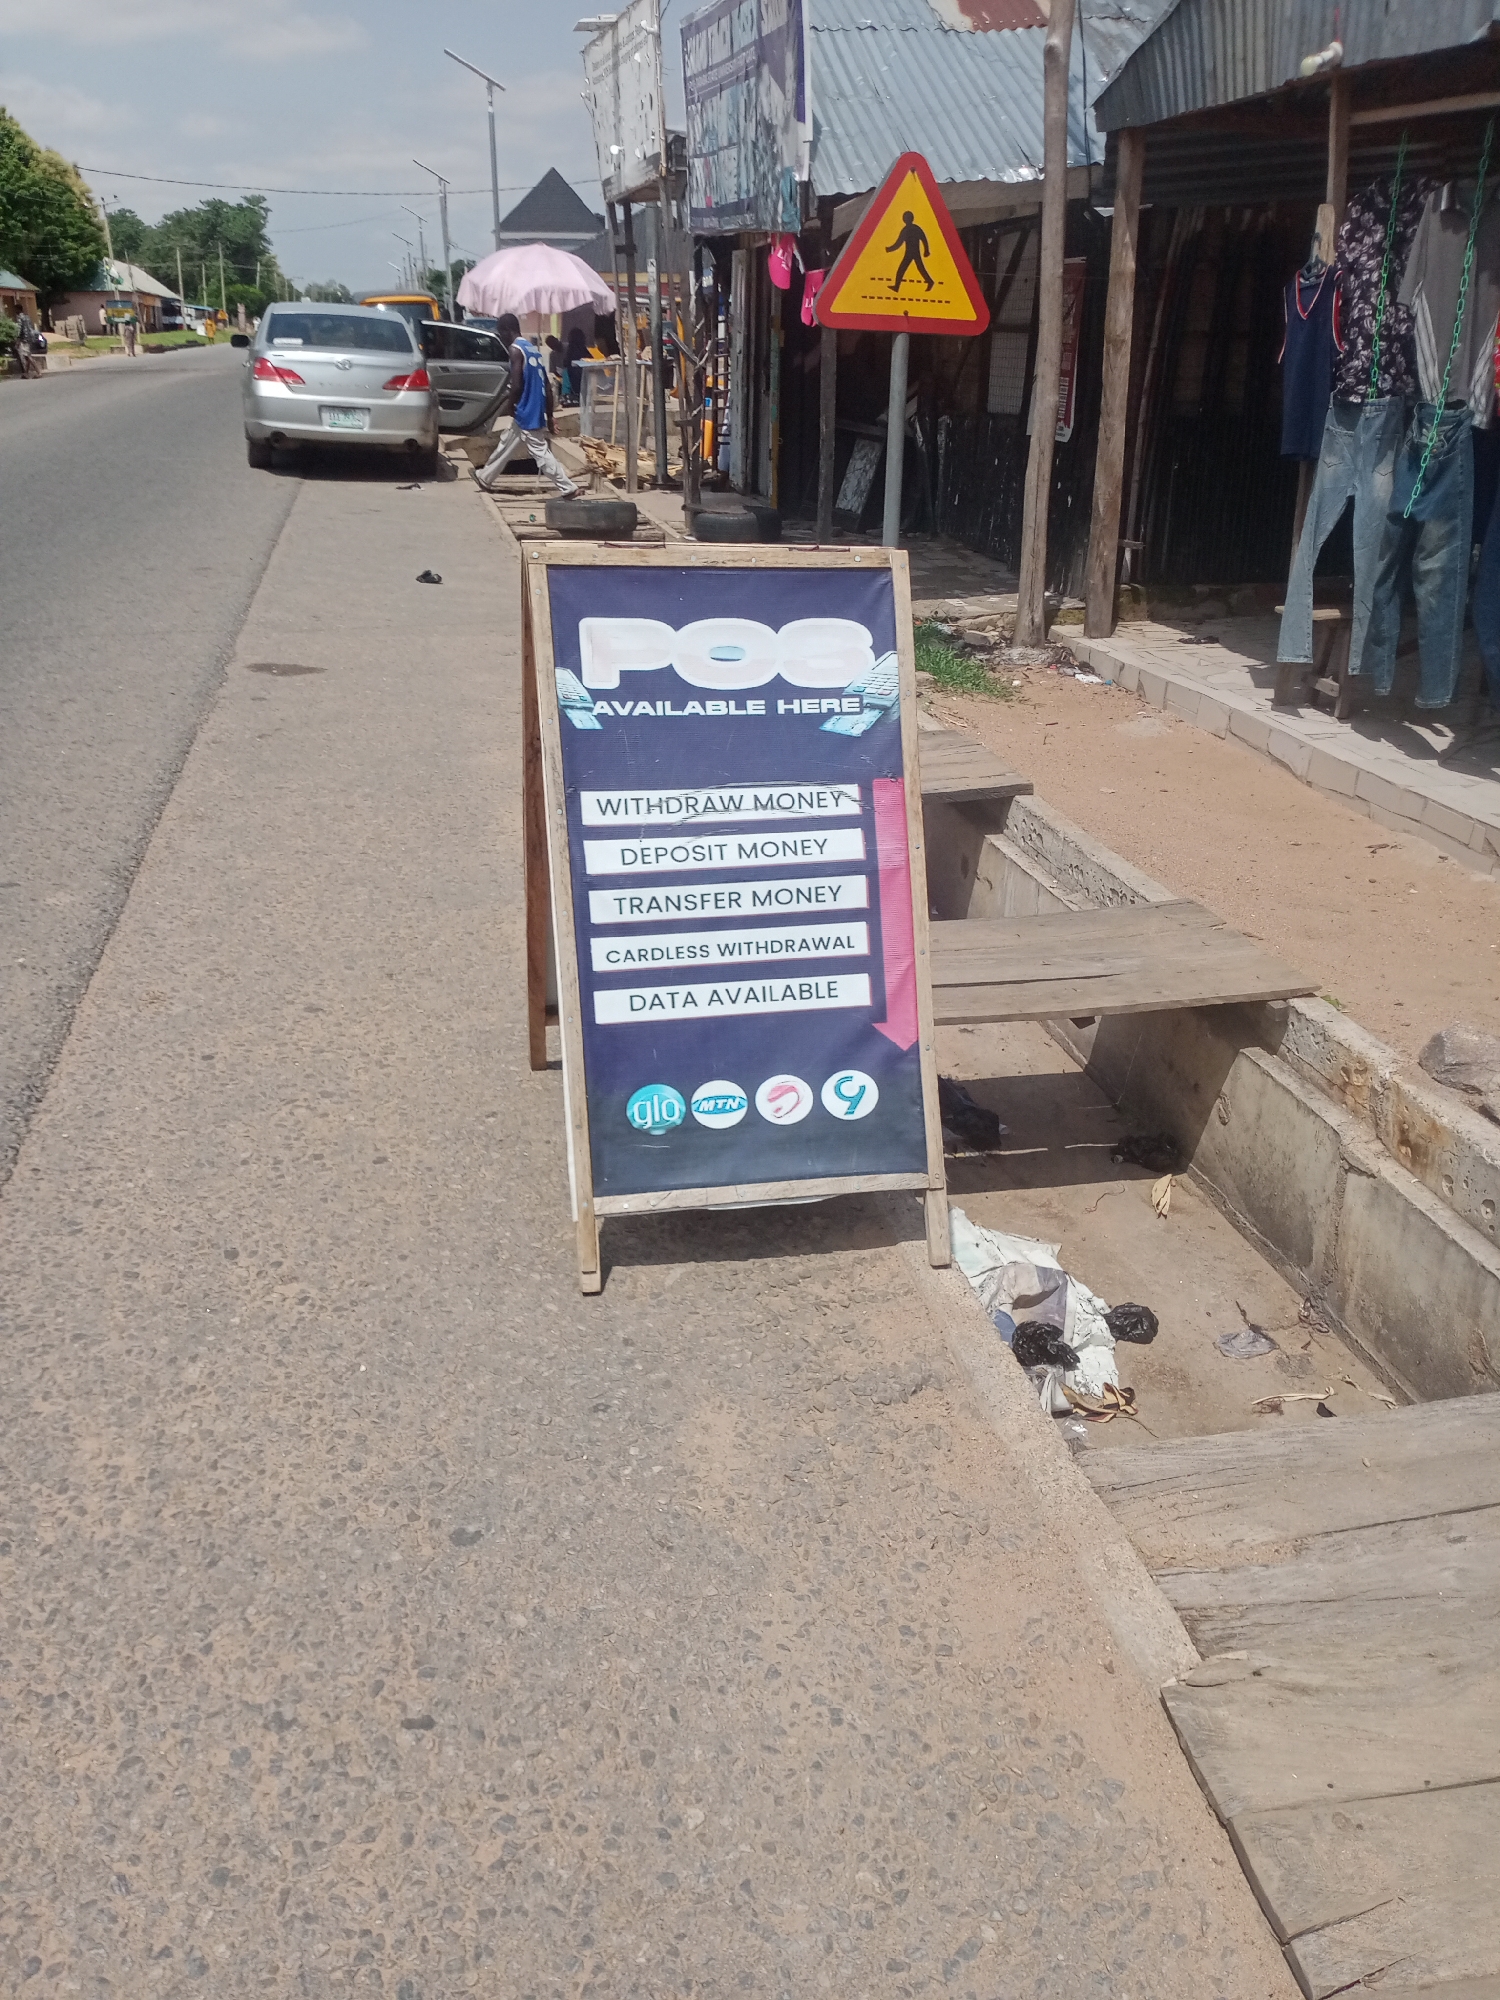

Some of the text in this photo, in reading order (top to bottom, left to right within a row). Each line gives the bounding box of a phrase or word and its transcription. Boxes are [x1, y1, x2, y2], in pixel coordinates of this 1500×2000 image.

[579, 617, 876, 690] POS
[592, 698, 861, 716] AVAILABLE HERE
[597, 791, 843, 816] WITHDRAW MONEY
[621, 838, 828, 866] DEPOSIT MONEY
[613, 885, 842, 915] TRANSFER MONEY
[606, 936, 855, 963] CARDLESS WITHDRAWAL
[630, 981, 839, 1012] DATA AVAILABLE
[634, 1094, 680, 1129] glo
[699, 1097, 741, 1113] MTN
